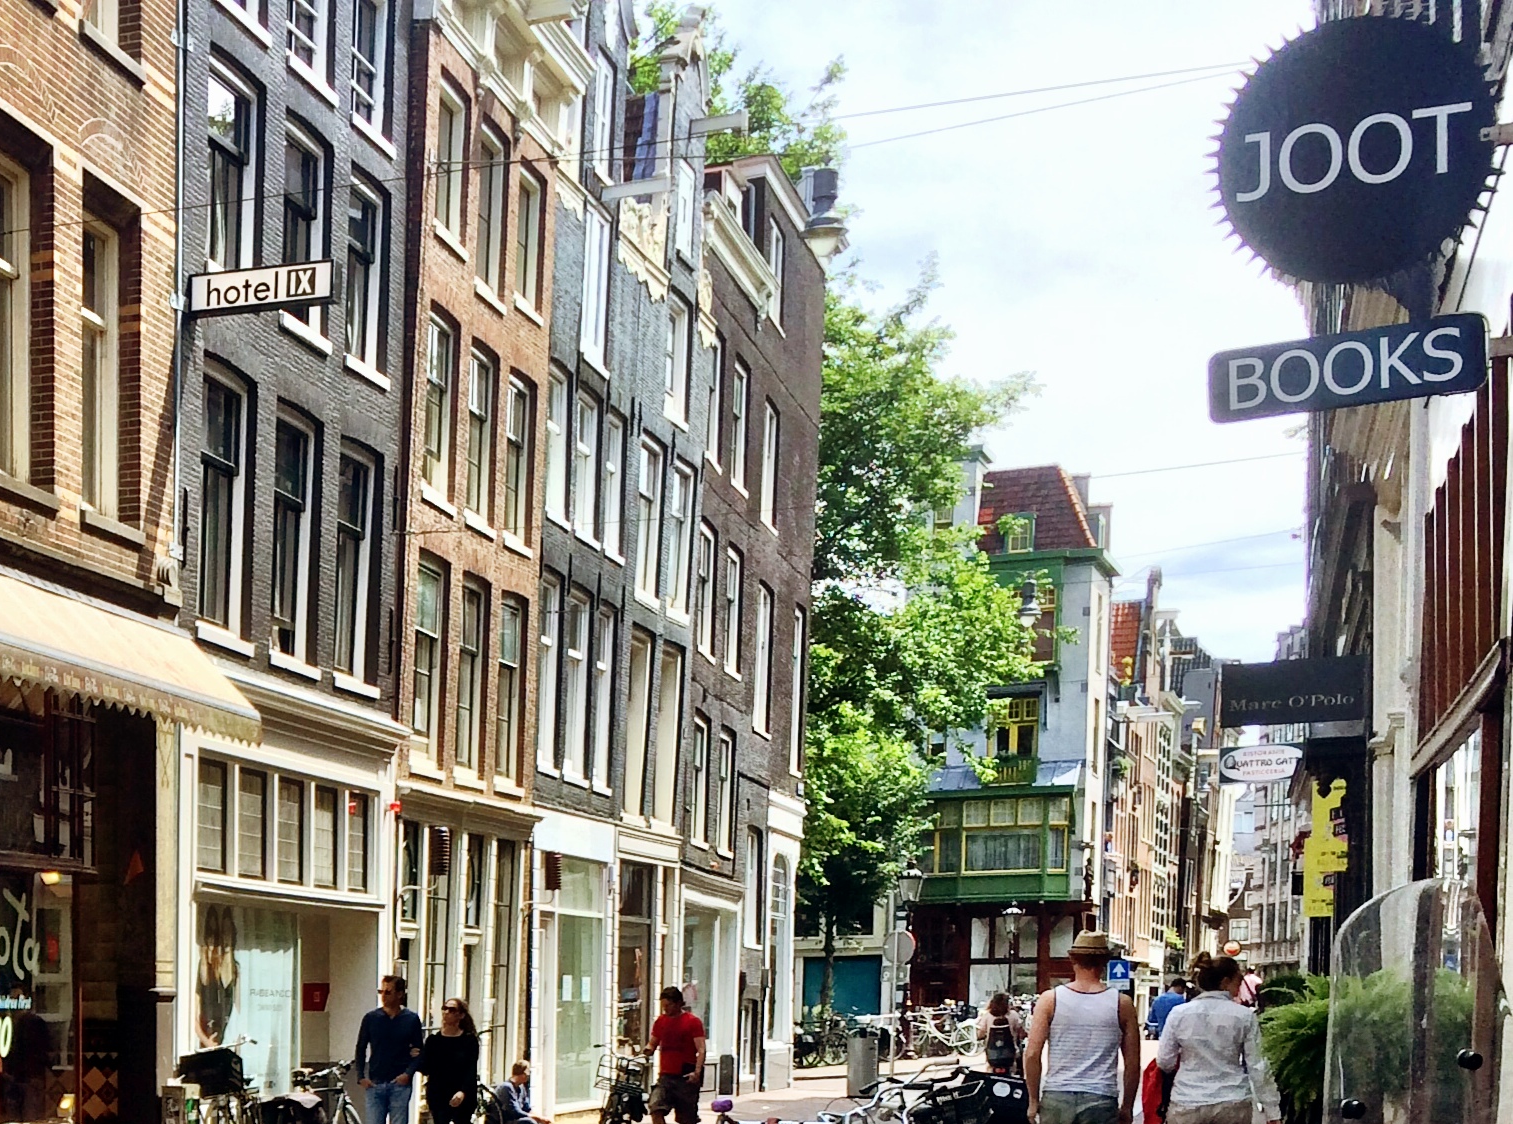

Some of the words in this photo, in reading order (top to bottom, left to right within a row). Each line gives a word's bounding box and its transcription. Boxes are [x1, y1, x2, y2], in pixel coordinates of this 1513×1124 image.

[1236, 101, 1473, 203] JOOT
[206, 271, 279, 307] hotel
[288, 269, 314, 297] IX
[1228, 327, 1464, 411] BOOKS
[1229, 699, 1282, 712] Marc
[1289, 693, 1354, 708] O'Polo
[1224, 755, 1273, 772] QUATTRO
